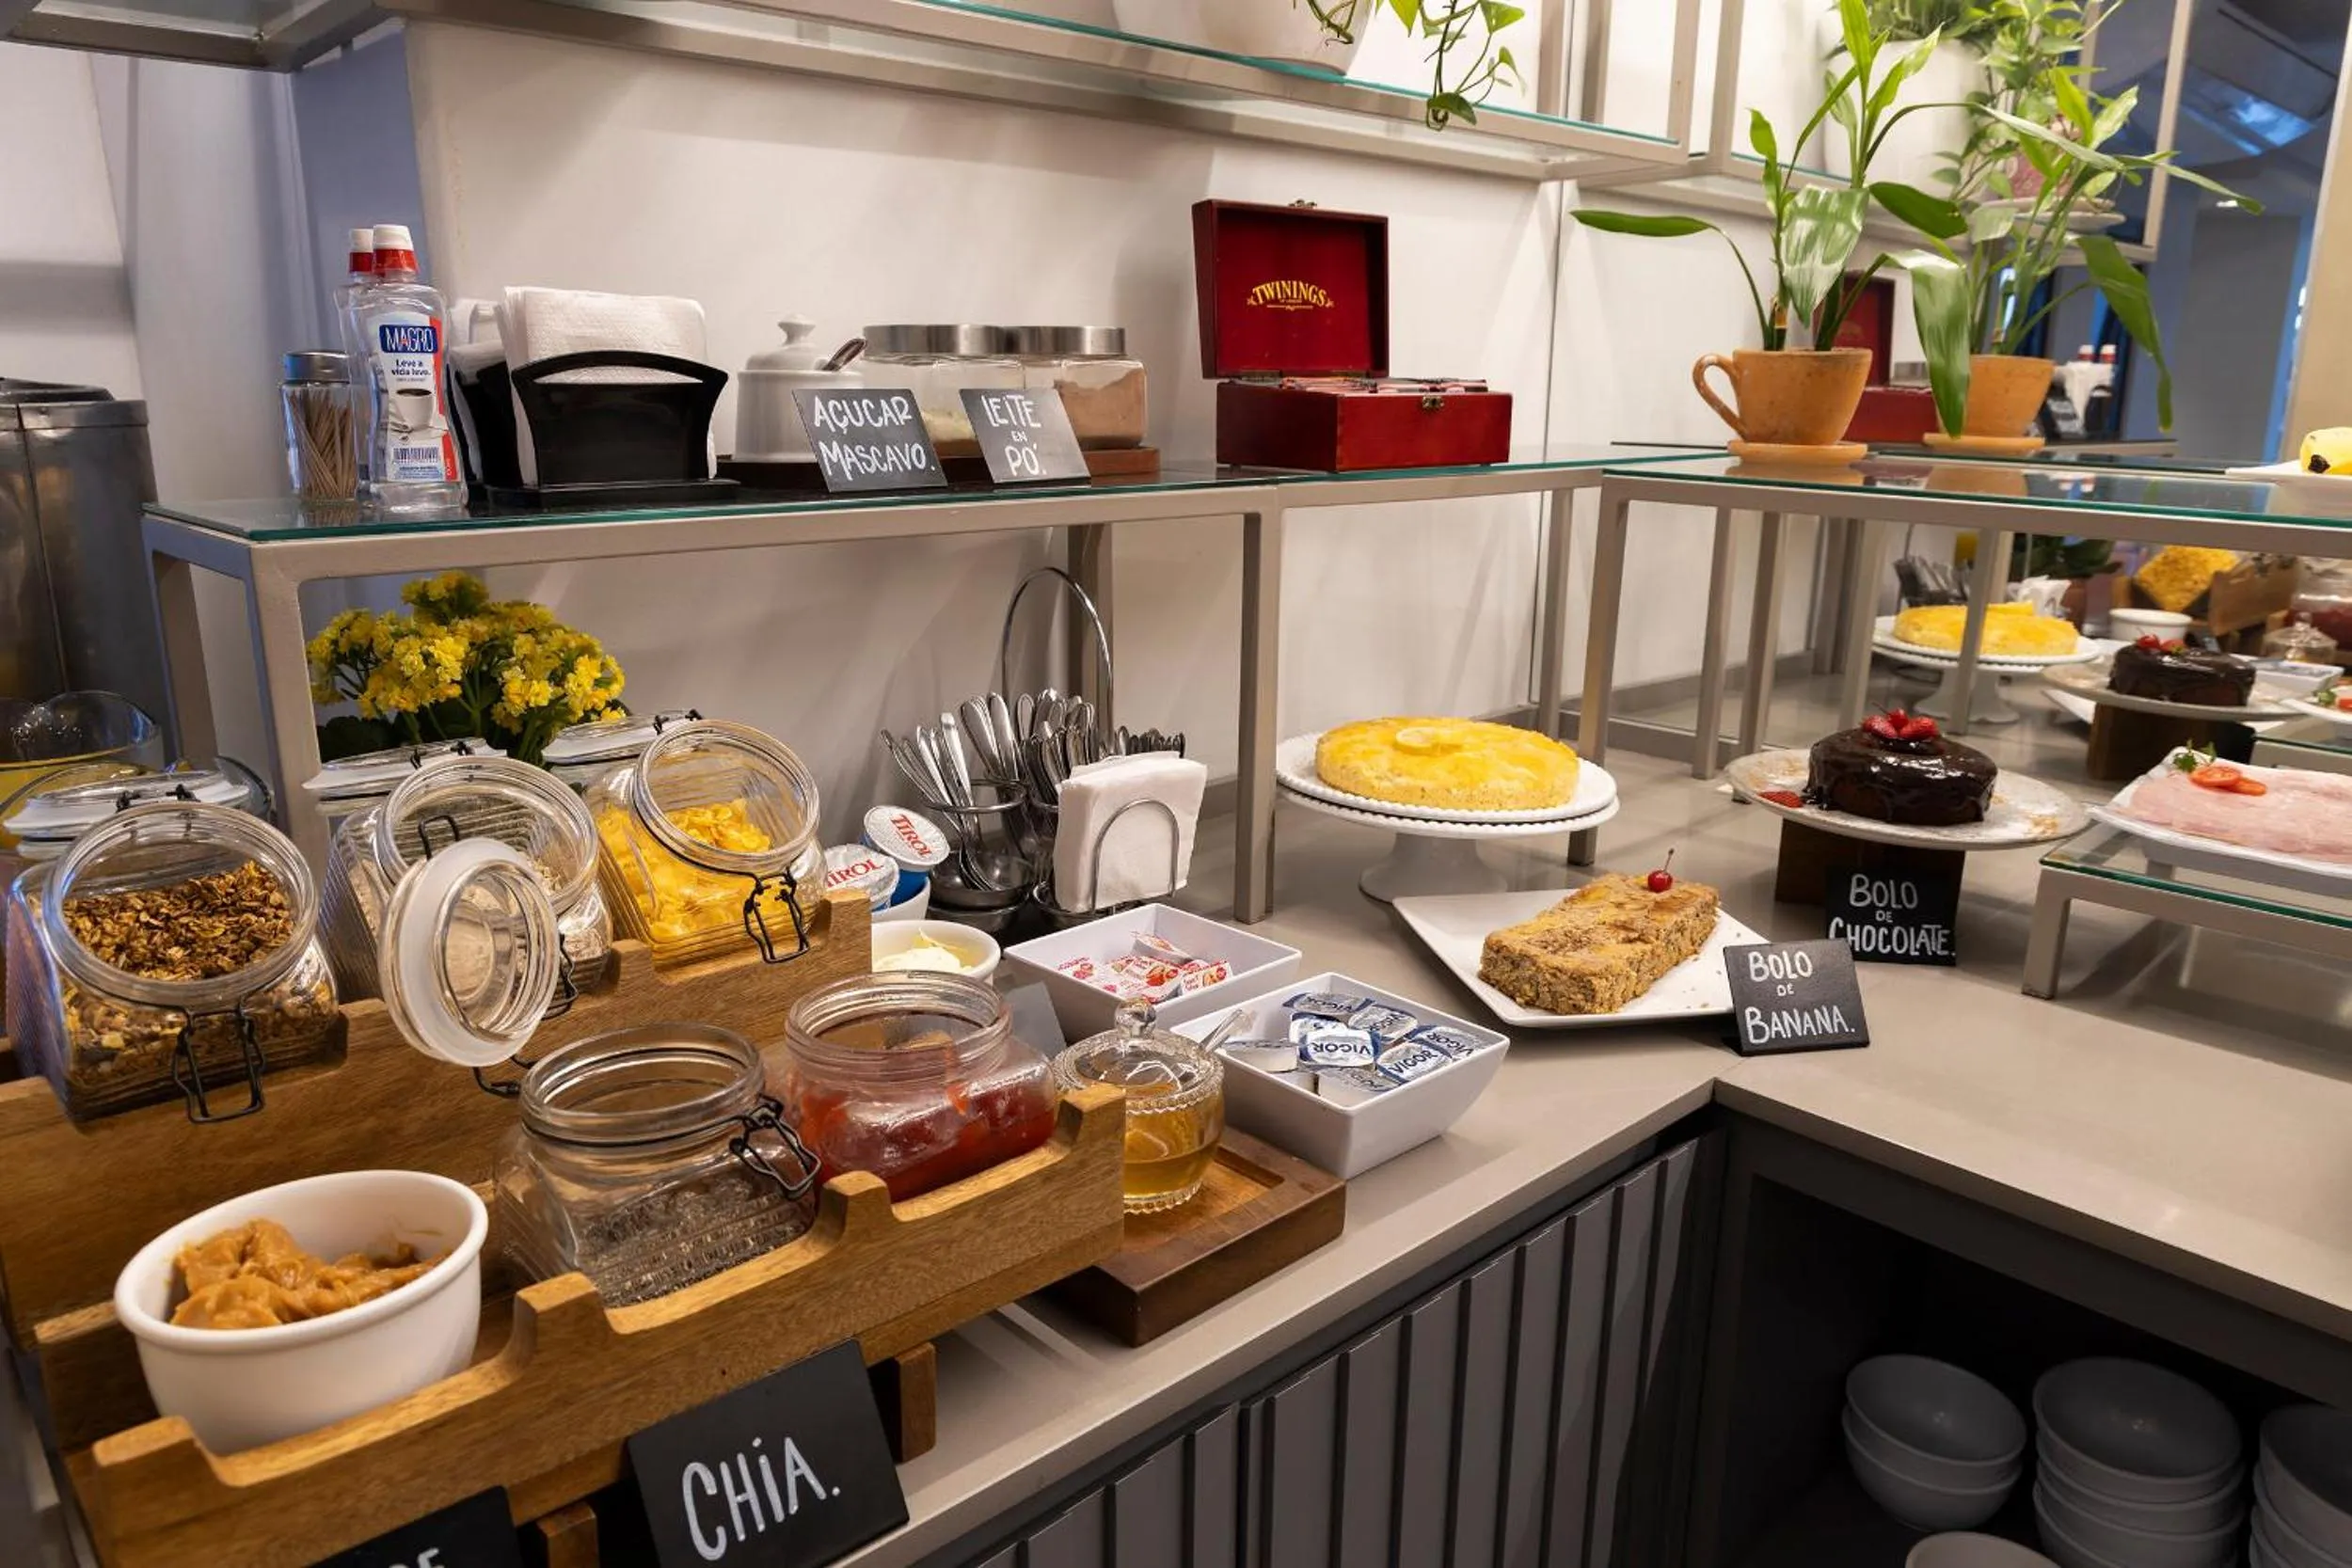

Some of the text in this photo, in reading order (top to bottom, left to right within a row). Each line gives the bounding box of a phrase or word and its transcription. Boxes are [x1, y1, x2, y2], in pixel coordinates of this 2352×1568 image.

[1252, 280, 1327, 307] TWININGS
[385, 326, 434, 352] MAGRO
[814, 395, 913, 434] AÇUCAR
[818, 440, 936, 481] MASCAVO.
[890, 814, 932, 859] TIROL
[1849, 873, 1917, 909] BOLO
[1875, 910, 1894, 923] DE
[1748, 950, 1814, 982] BOLO
[1775, 982, 1795, 997] DE
[1744, 1005, 1856, 1044] BANANA.
[1311, 1042, 1372, 1054] VIGOR
[1427, 1032, 1474, 1056] VIGOR
[1388, 1049, 1438, 1074] VIGOR
